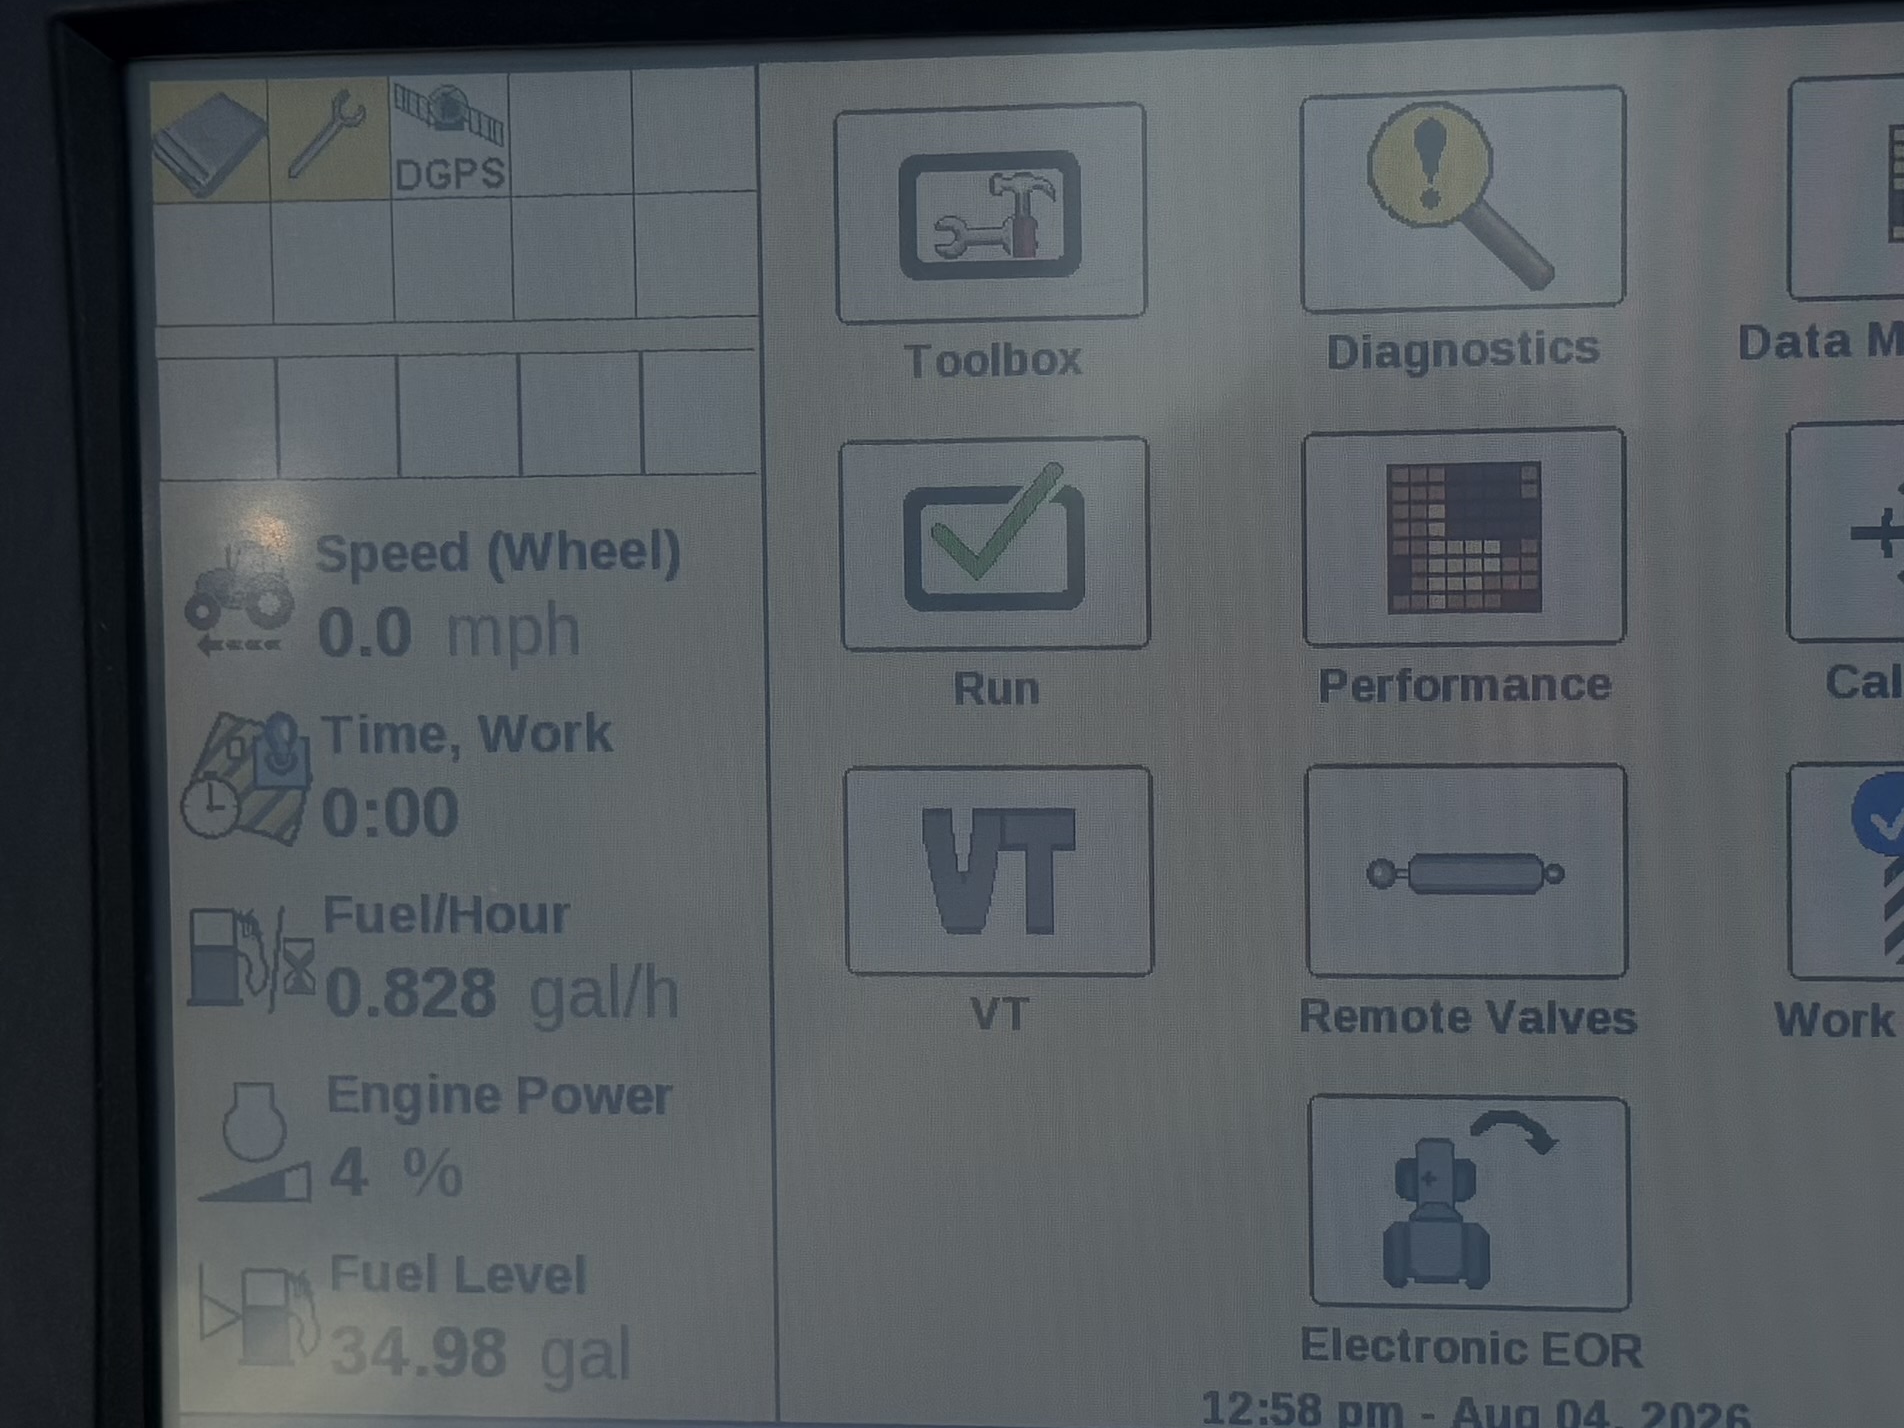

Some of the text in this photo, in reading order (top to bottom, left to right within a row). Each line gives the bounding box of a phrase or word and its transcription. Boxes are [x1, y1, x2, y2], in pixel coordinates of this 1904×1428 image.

[396, 157, 506, 192] DGPS
[904, 343, 1082, 379] Toolbox
[1327, 330, 1601, 378] Diagnostics
[1739, 323, 1852, 361] Data
[316, 529, 681, 584] Speed (Wheel)
[319, 600, 580, 669] 0.0 mph
[953, 670, 1040, 706] Run
[1319, 668, 1613, 705] Performance
[322, 712, 614, 763] Time, Work
[322, 787, 459, 838] 0:00
[922, 808, 1076, 934] VT
[324, 893, 571, 934] Fuel/Hour
[326, 963, 678, 1032] 0.828 gal/h
[970, 996, 1030, 1031] VT
[1300, 998, 1639, 1036] Remote Valves
[1775, 1002, 1897, 1039] Work
[327, 1073, 673, 1125] Engine Power
[330, 1147, 463, 1198] 4 %
[331, 1253, 587, 1295] Fuel Level
[331, 1324, 629, 1393] 34.98 gal
[1302, 1327, 1645, 1369] Electronic EOR
[1203, 1390, 1323, 1428] 12:58
